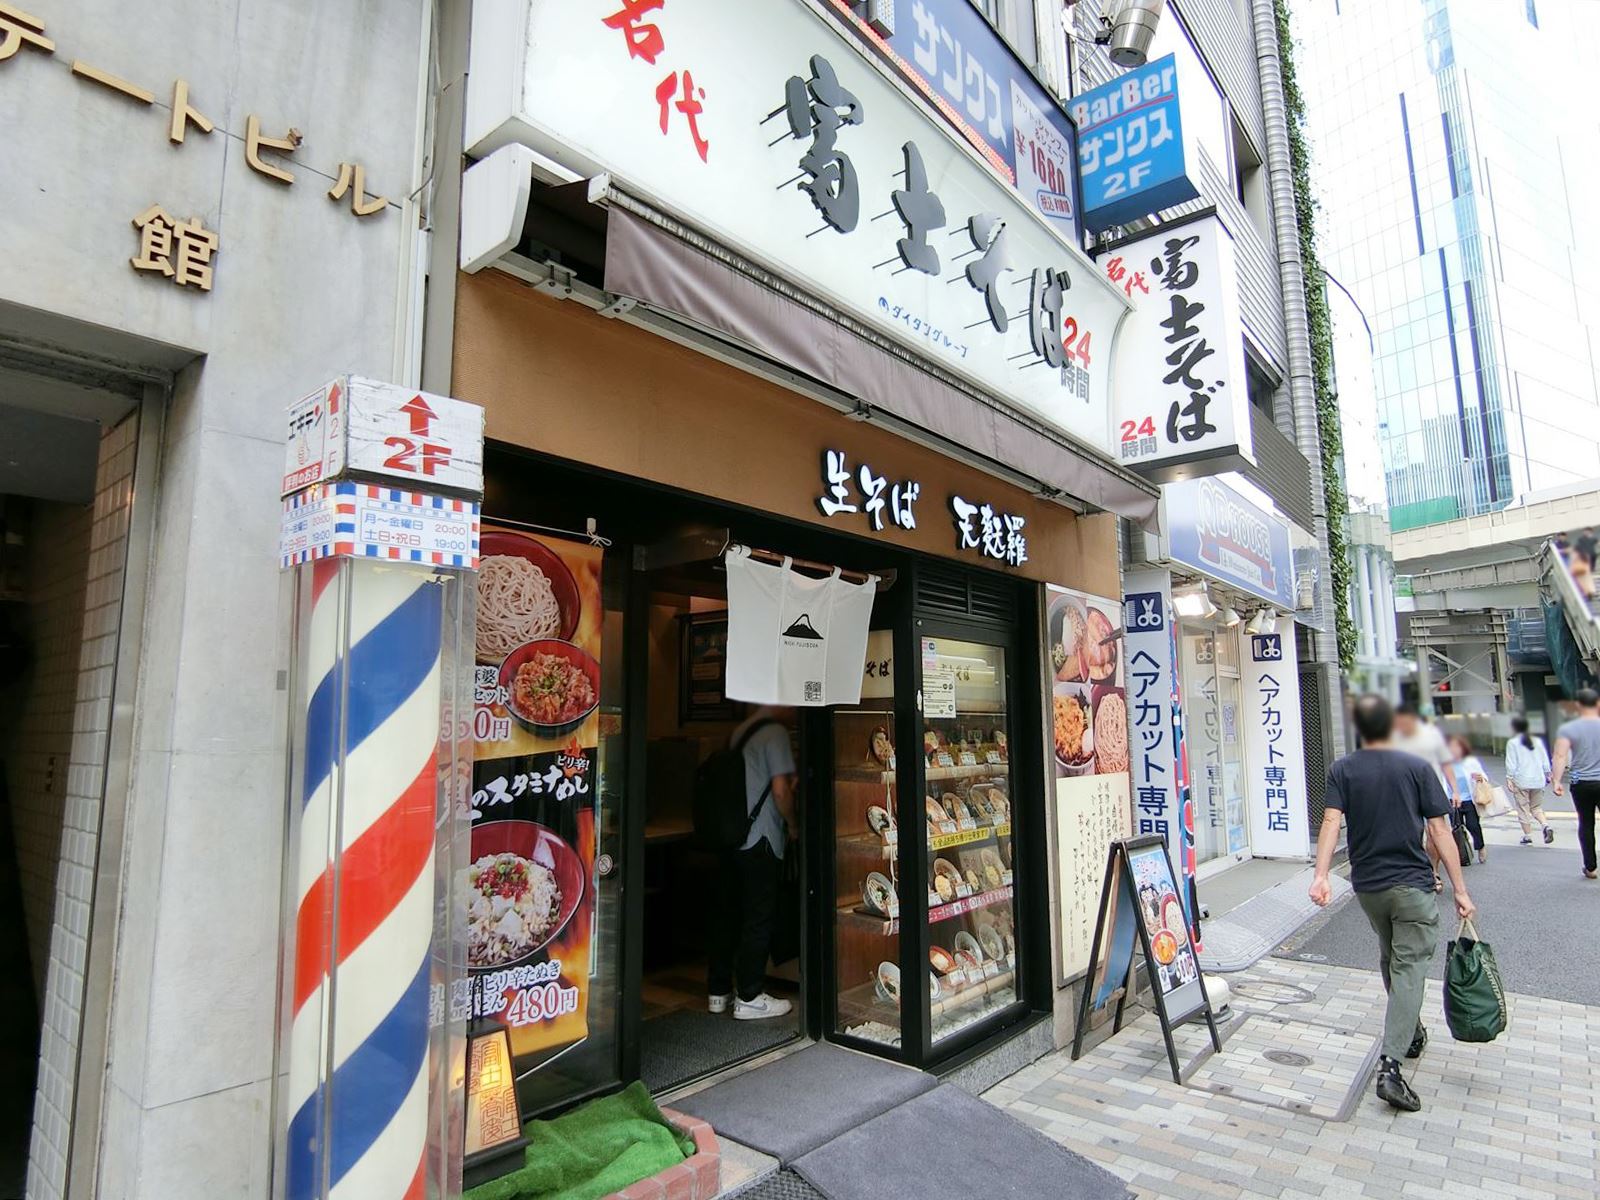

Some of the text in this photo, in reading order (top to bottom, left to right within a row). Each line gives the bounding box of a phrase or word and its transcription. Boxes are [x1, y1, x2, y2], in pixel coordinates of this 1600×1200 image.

[911, 2, 1008, 149] サンクス
[1072, 65, 1175, 130] BarBer
[1080, 107, 1174, 177] サンクス
[1102, 160, 1152, 200] 2F
[785, 54, 1072, 368] 富士そば
[130, 204, 219, 291] 館
[1106, 256, 1150, 298] 名代
[892, 304, 969, 359] ダイタングループ
[1063, 316, 1092, 370] 24
[1150, 235, 1226, 444] 富士そば
[1060, 362, 1091, 404] 時間
[383, 436, 452, 476] 2F
[1120, 416, 1156, 442] 24
[1121, 436, 1158, 459] 時間
[820, 449, 921, 532] 生そば
[434, 523, 467, 536] 20:00
[434, 537, 467, 551] 19:00
[1257, 672, 1290, 833] ヘアカット専門店
[510, 984, 577, 1022] 480円
